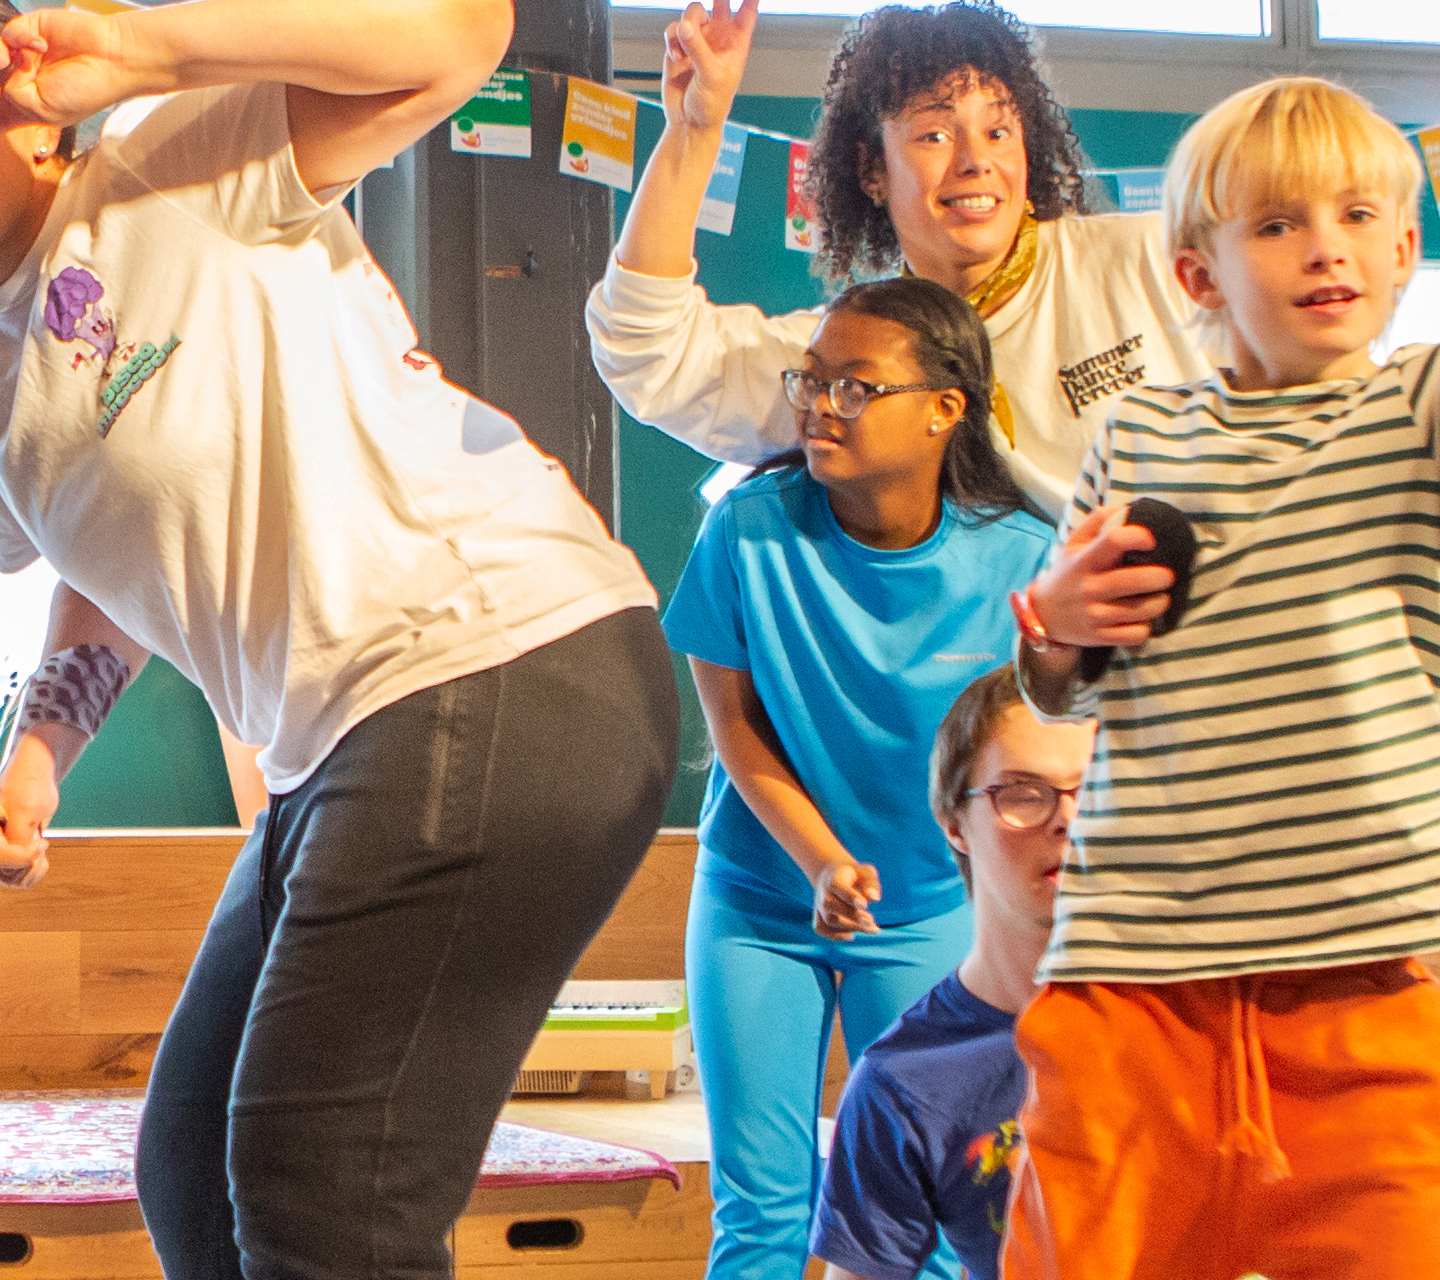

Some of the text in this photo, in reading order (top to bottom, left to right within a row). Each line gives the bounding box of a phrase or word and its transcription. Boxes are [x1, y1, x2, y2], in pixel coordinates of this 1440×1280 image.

[102, 342, 157, 407] DISCO
[1058, 333, 1143, 378] Summer
[1060, 360, 1126, 400] Dance
